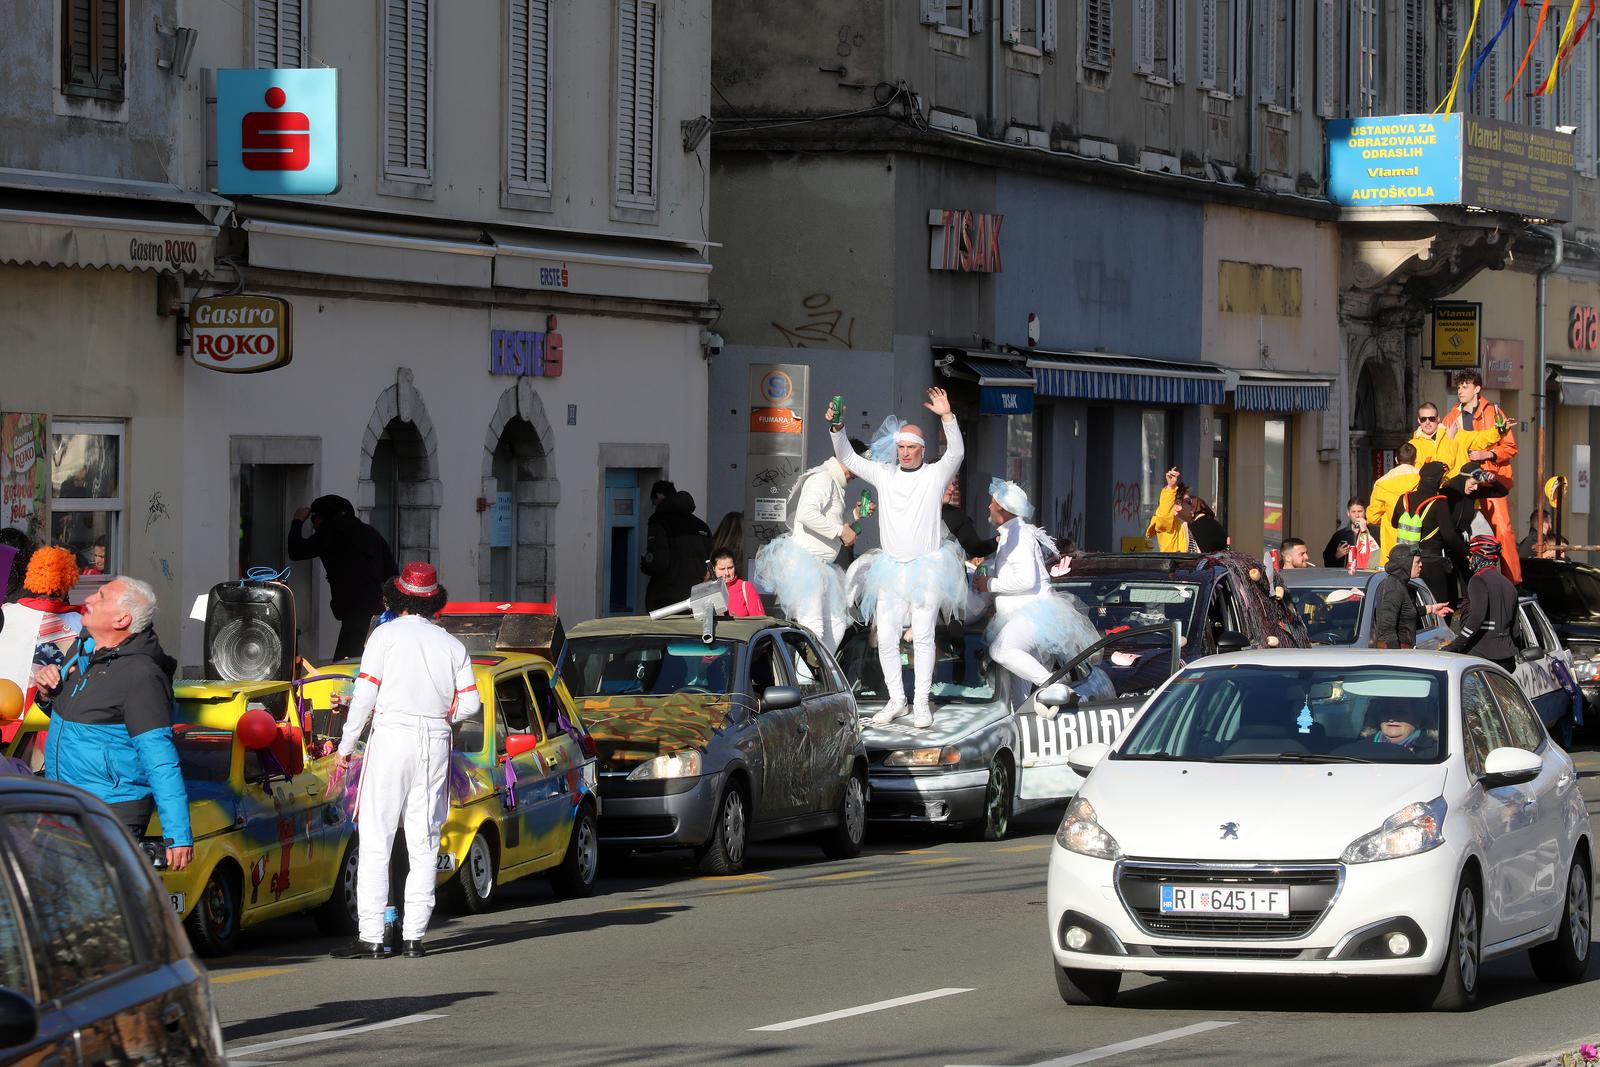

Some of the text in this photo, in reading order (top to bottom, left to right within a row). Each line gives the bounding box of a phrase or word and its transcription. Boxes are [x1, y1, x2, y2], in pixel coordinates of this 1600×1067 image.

[1351, 123, 1435, 136] USTANOVA ZA
[1466, 120, 1502, 151] Vlamal
[1348, 135, 1437, 148] OBRAZOVANJE
[1362, 147, 1423, 159] ODRASLIH
[1367, 165, 1419, 177] Vlamal
[1351, 184, 1434, 200] AUTOŠKOLA
[928, 208, 1004, 273] TISAK
[130, 238, 197, 270] Gastro ROKO
[540, 267, 561, 287] ERSTE
[195, 304, 274, 325] Gastro
[1569, 304, 1599, 350] ara
[196, 334, 275, 362] ROKO
[491, 329, 545, 376] ERSTE
[758, 416, 788, 424] FIUMARA
[15, 446, 34, 469] ROKO
[1174, 889, 1279, 911] RI 6451-F
